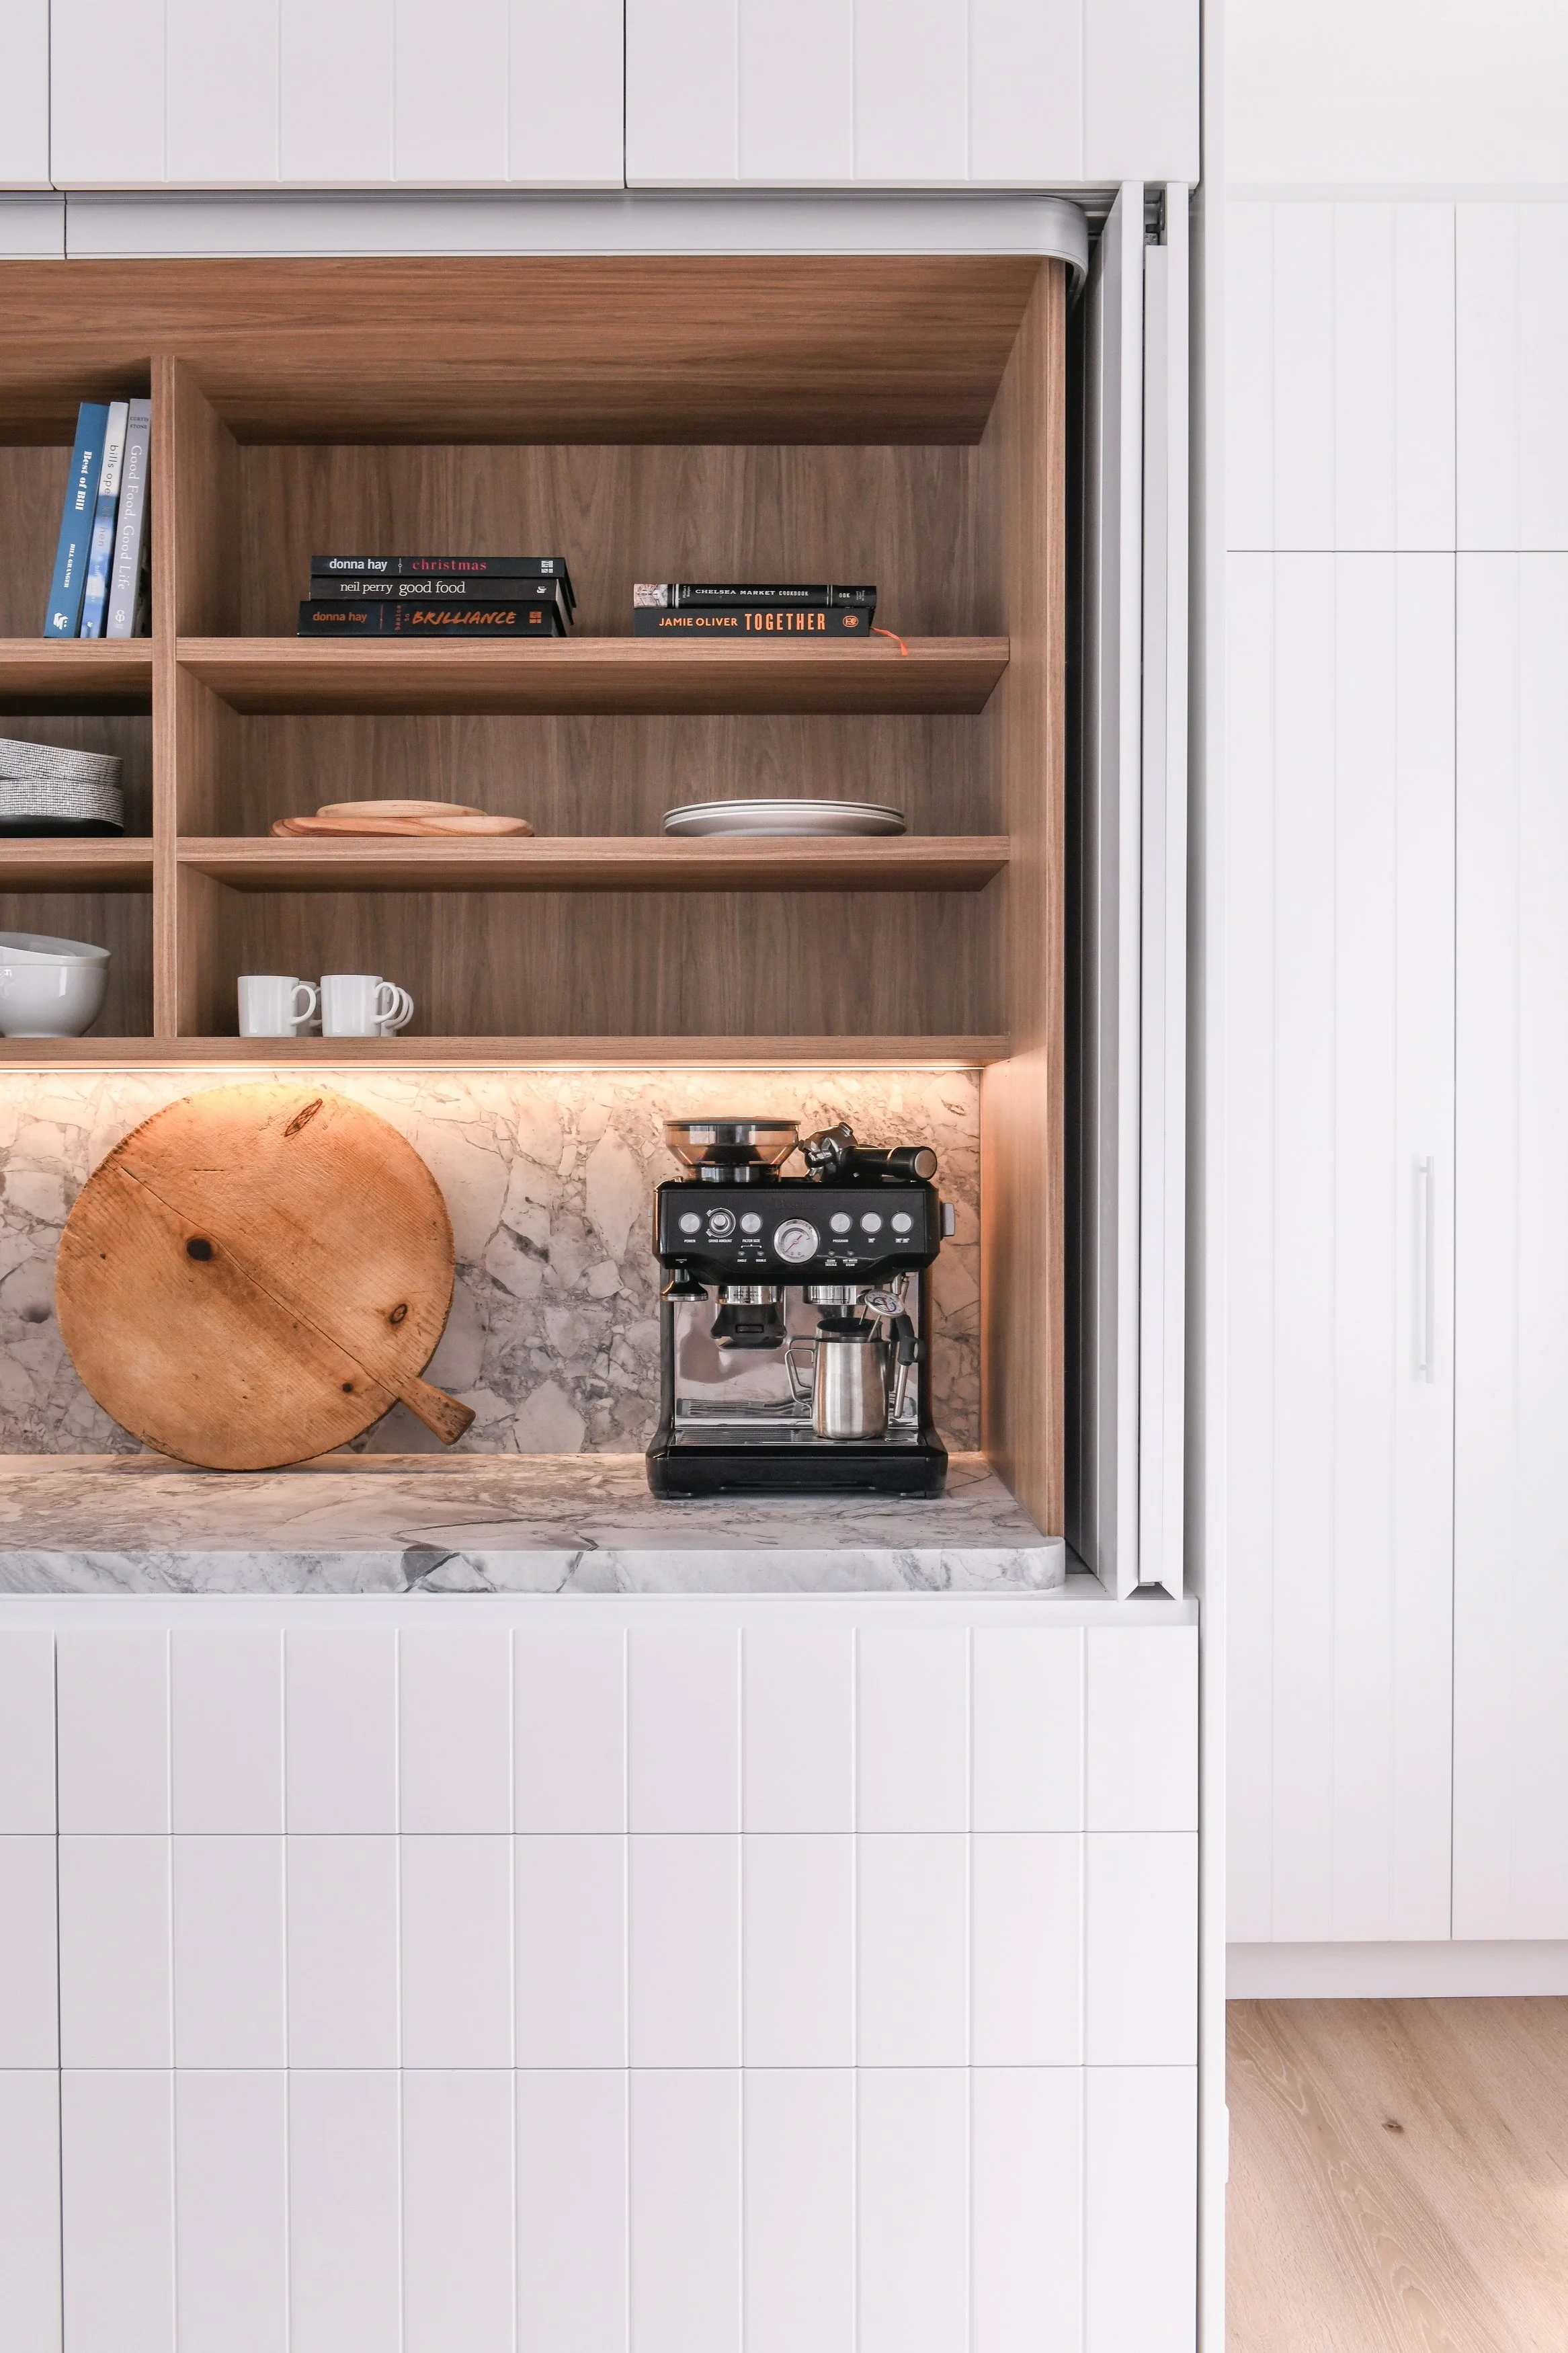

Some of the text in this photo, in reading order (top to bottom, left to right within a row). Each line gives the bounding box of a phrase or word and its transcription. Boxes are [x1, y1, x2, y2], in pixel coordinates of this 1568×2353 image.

[108, 444, 119, 468] bills
[75, 450, 92, 510] Best of Bill
[118, 445, 142, 589] Good Food, Good Life
[64, 559, 73, 588] GRANGER
[329, 559, 487, 571] donna hay christmas
[340, 581, 466, 596] neil perry good food
[313, 612, 368, 624] donna hay
[412, 610, 518, 625] BRILLIANCE
[659, 613, 826, 631] JAMIE OLIVER TOGETHER
